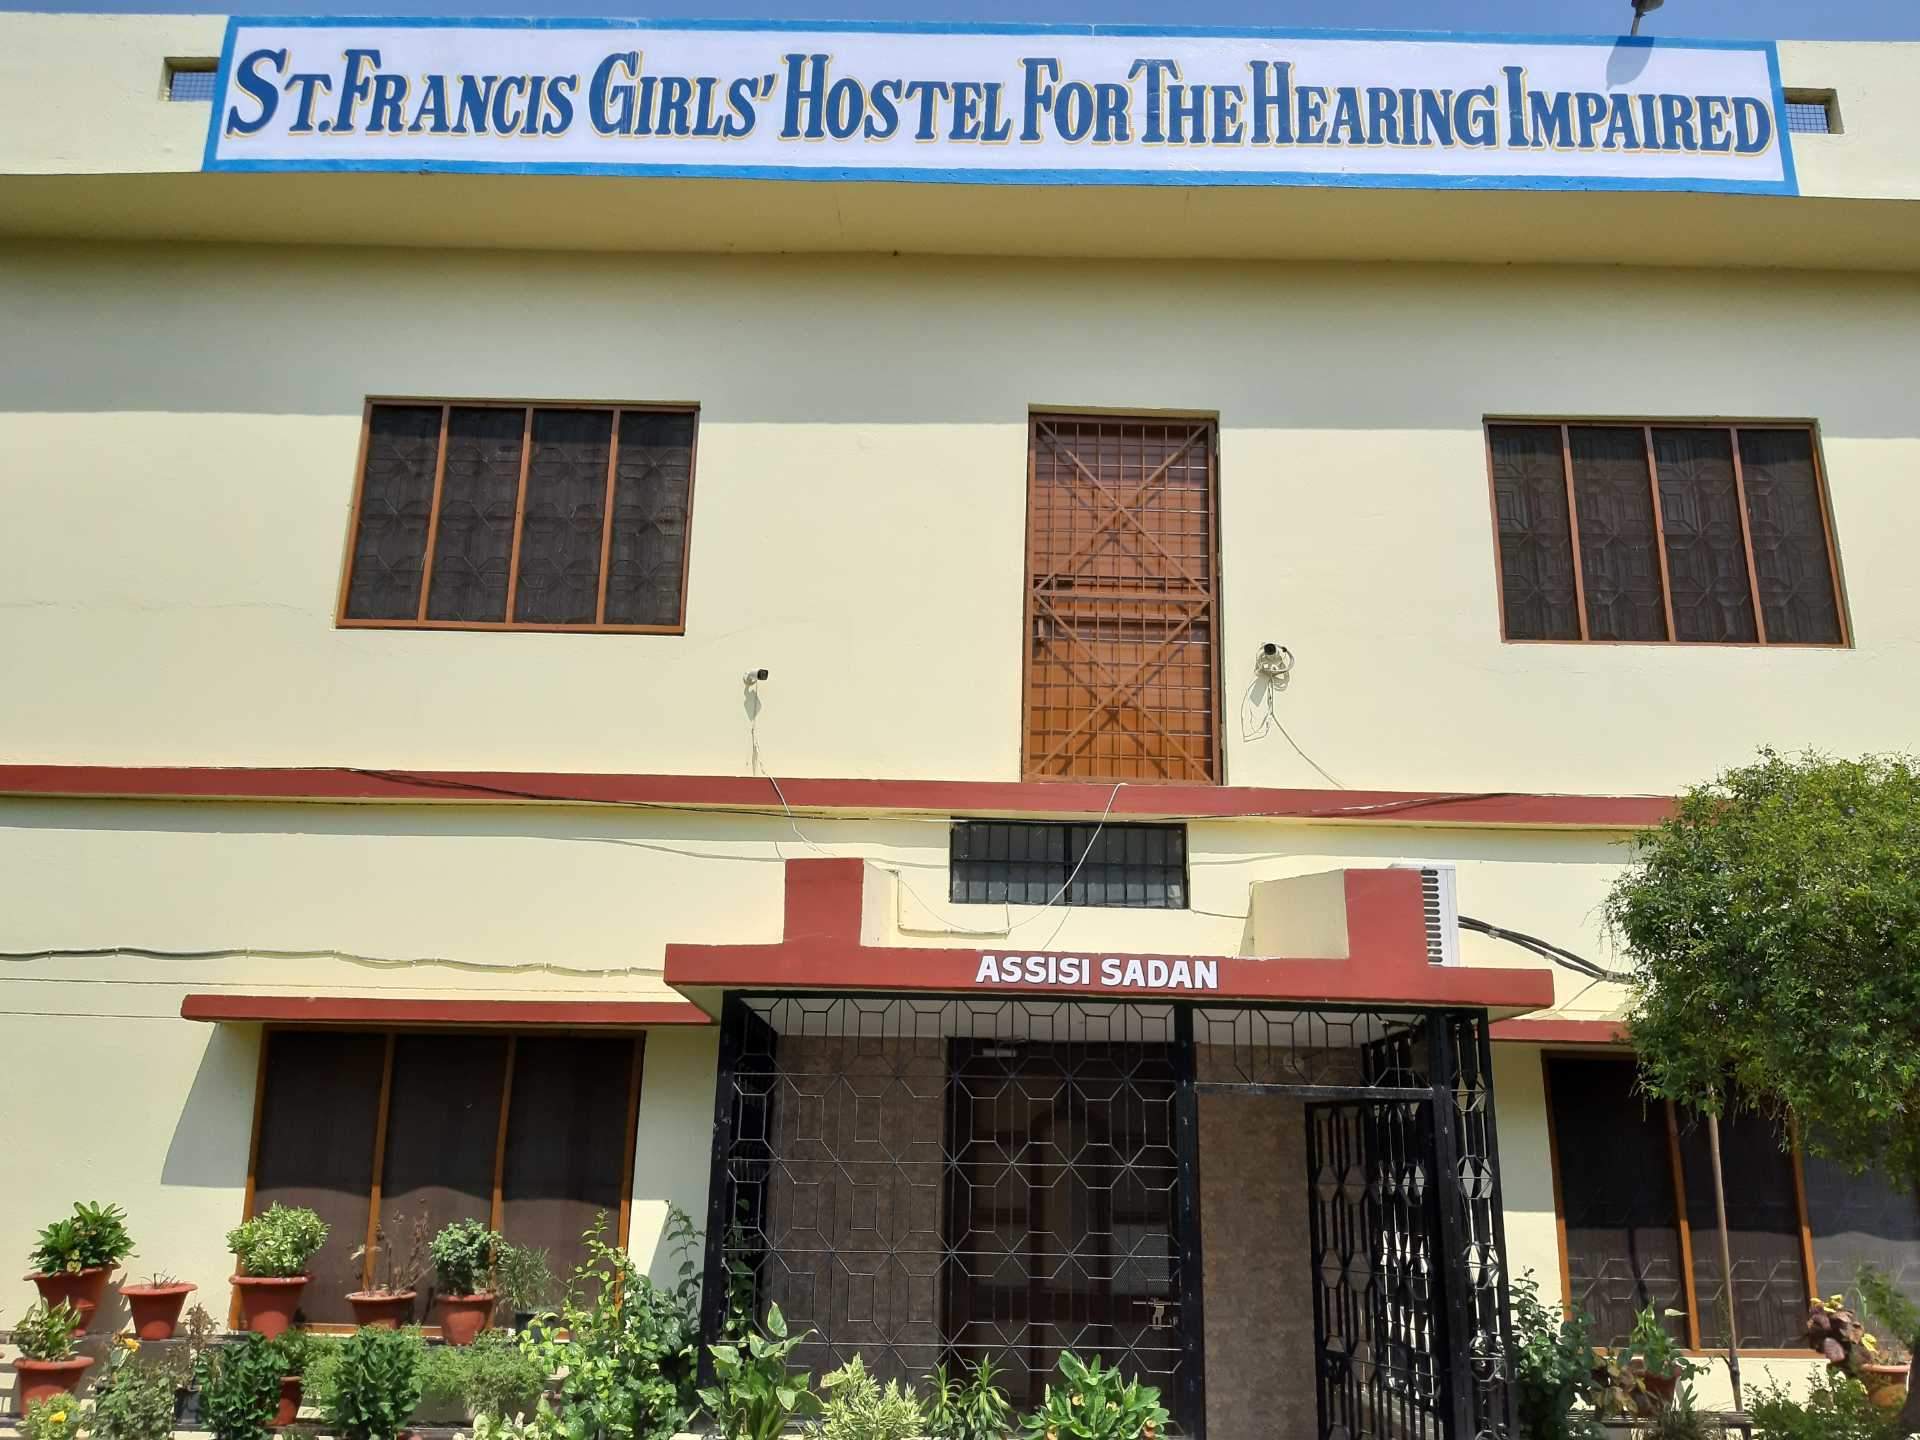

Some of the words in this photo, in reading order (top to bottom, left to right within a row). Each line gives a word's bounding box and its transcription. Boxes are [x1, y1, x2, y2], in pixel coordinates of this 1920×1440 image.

[779, 54, 1013, 143] HOSTEL
[1019, 57, 1132, 144] FOR
[1127, 58, 1246, 145] THE
[1247, 60, 1498, 150] HEARING
[1501, 65, 1772, 154] IMPAIRED
[975, 955, 1091, 985] ASSISI
[1100, 958, 1219, 989] SADAN
